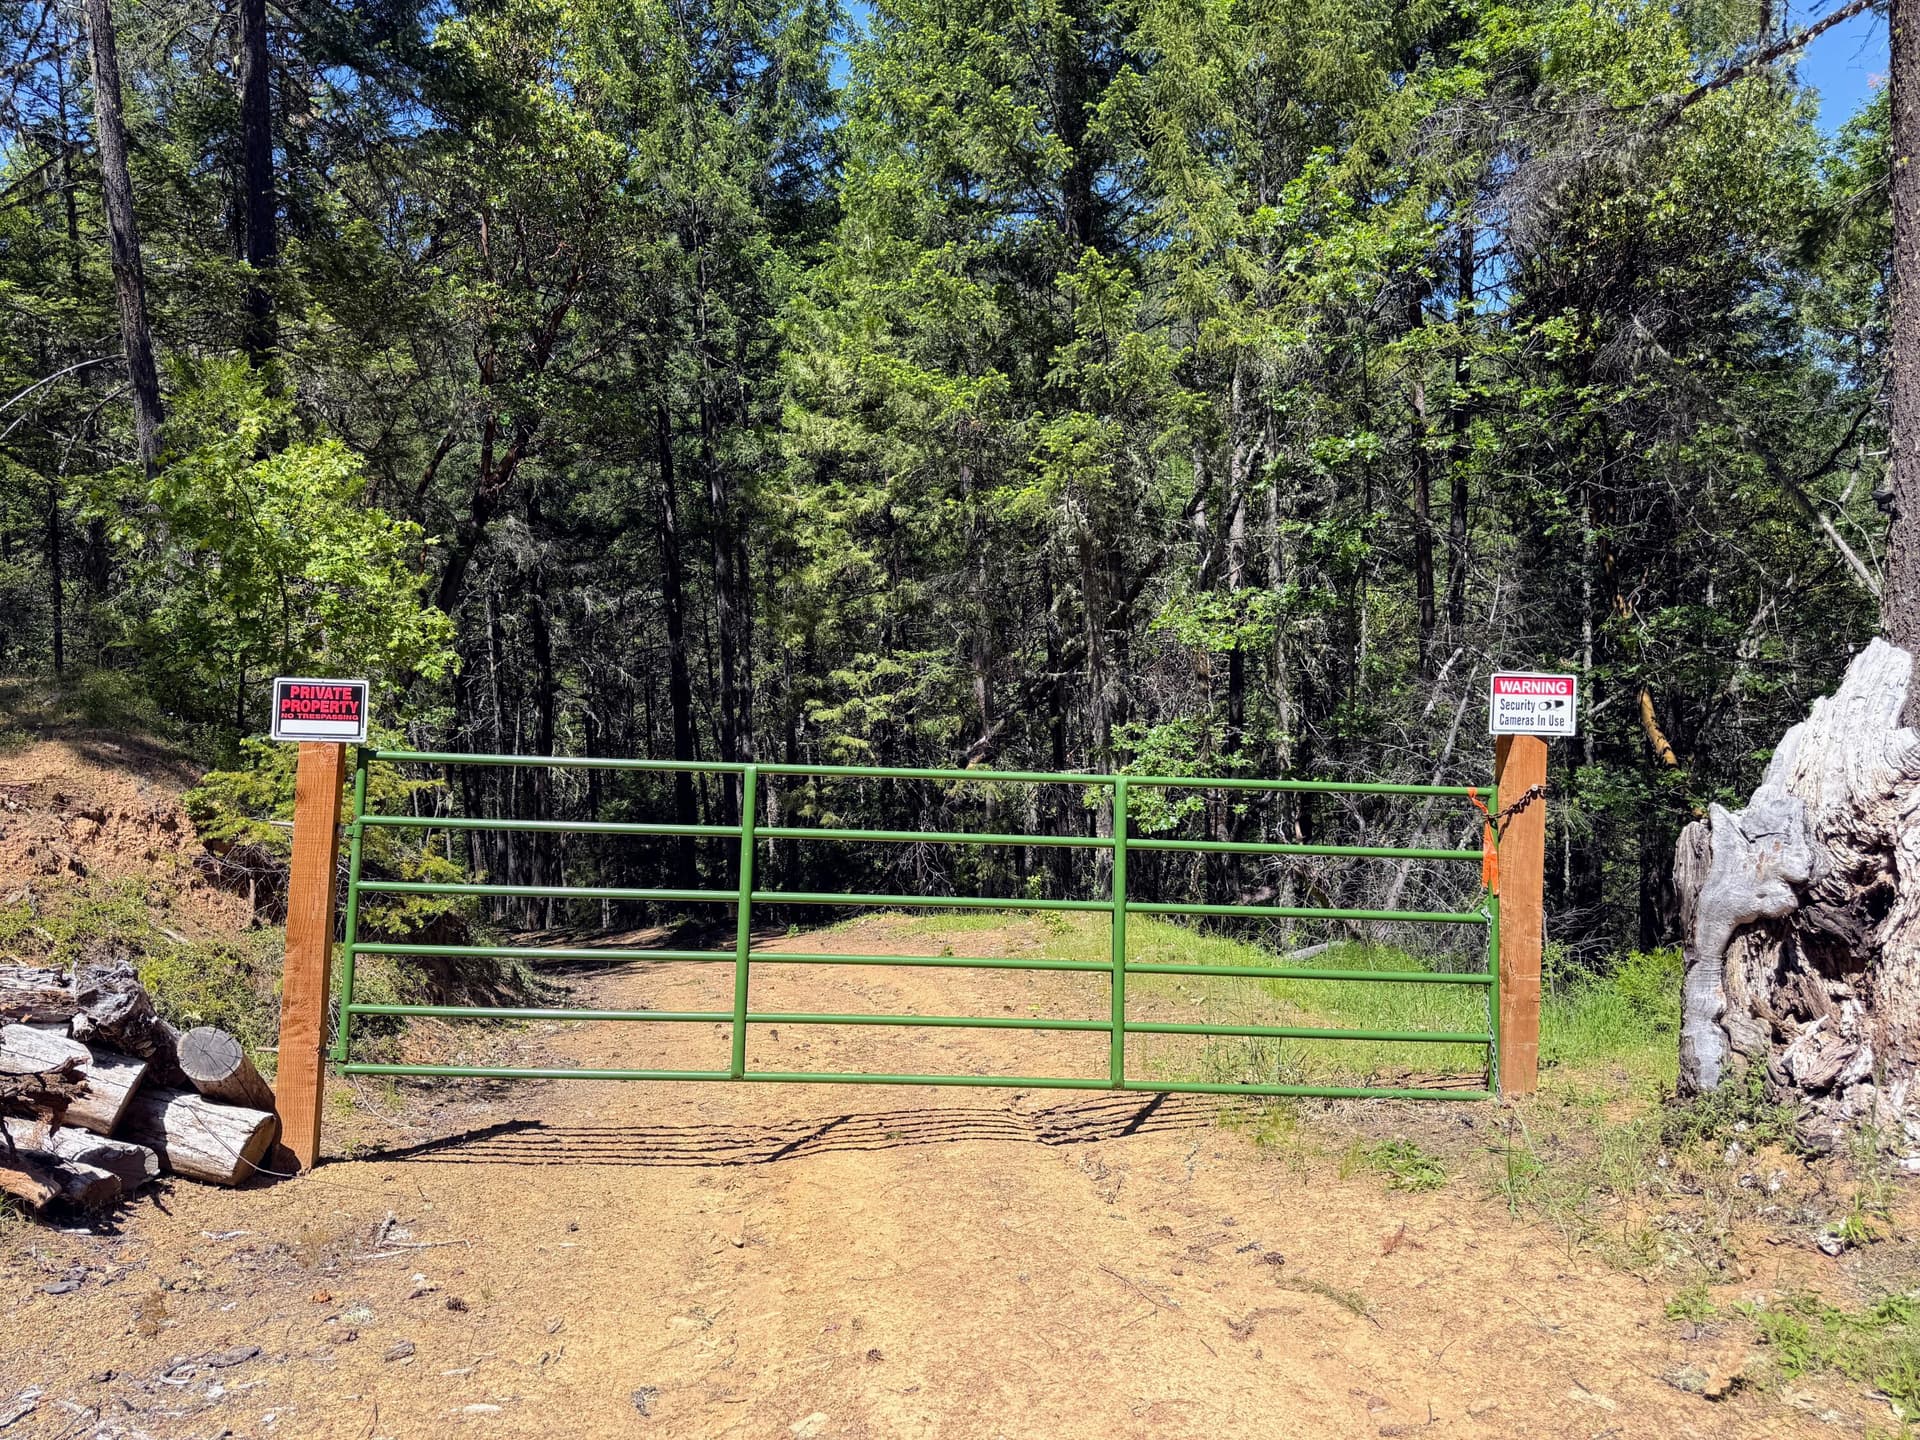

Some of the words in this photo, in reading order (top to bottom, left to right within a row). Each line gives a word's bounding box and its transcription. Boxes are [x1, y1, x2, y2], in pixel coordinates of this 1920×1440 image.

[290, 685, 353, 700] PRIVATE
[1500, 680, 1567, 694] WARNING
[281, 699, 359, 713] PROPERTY
[1500, 698, 1535, 713] Security
[1500, 713, 1534, 726] Cameras
[1537, 714, 1546, 726] In
[1549, 714, 1565, 727] Use
